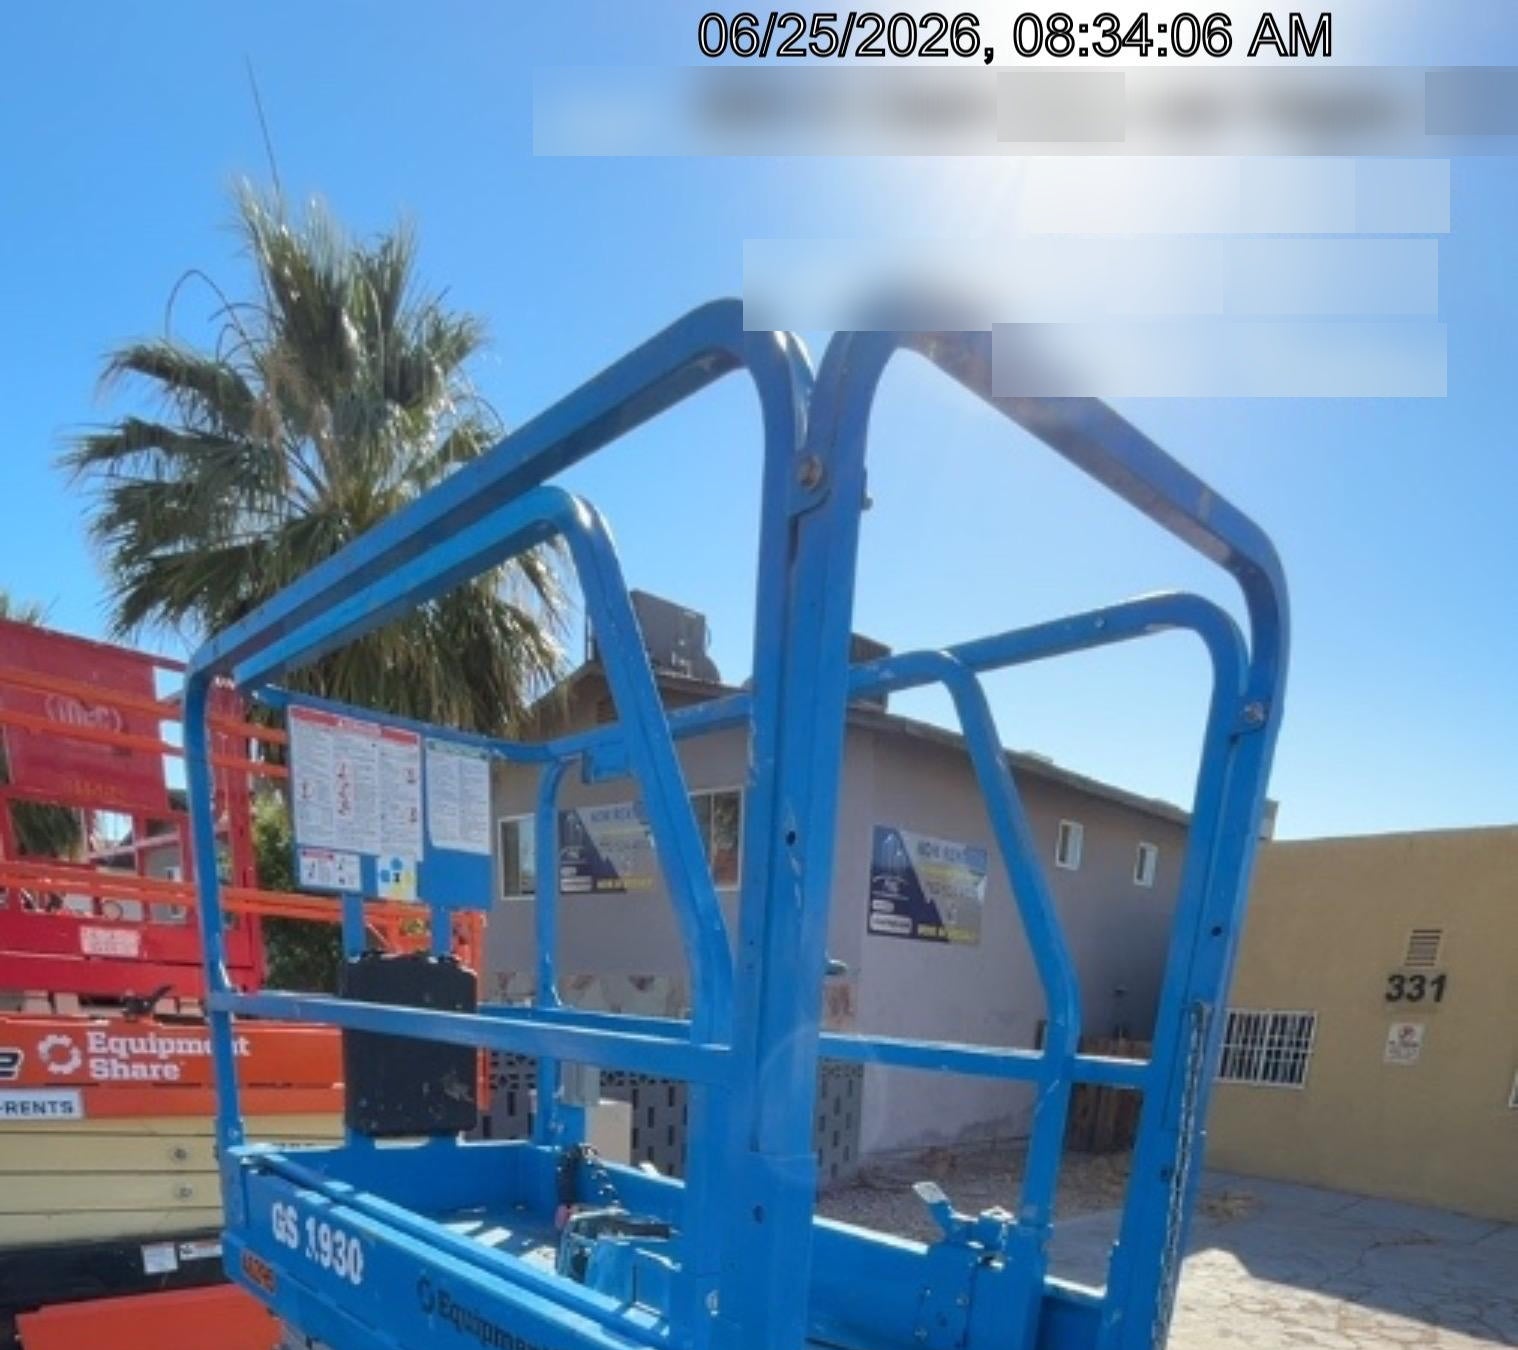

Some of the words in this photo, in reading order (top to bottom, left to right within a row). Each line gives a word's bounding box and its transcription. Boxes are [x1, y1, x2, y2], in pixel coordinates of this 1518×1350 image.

[1385, 973, 1447, 1003] 331
[87, 1031, 250, 1060] Equipmt
[90, 1059, 180, 1081] Share
[271, 1201, 299, 1250] GS
[305, 1215, 365, 1286] 1930
